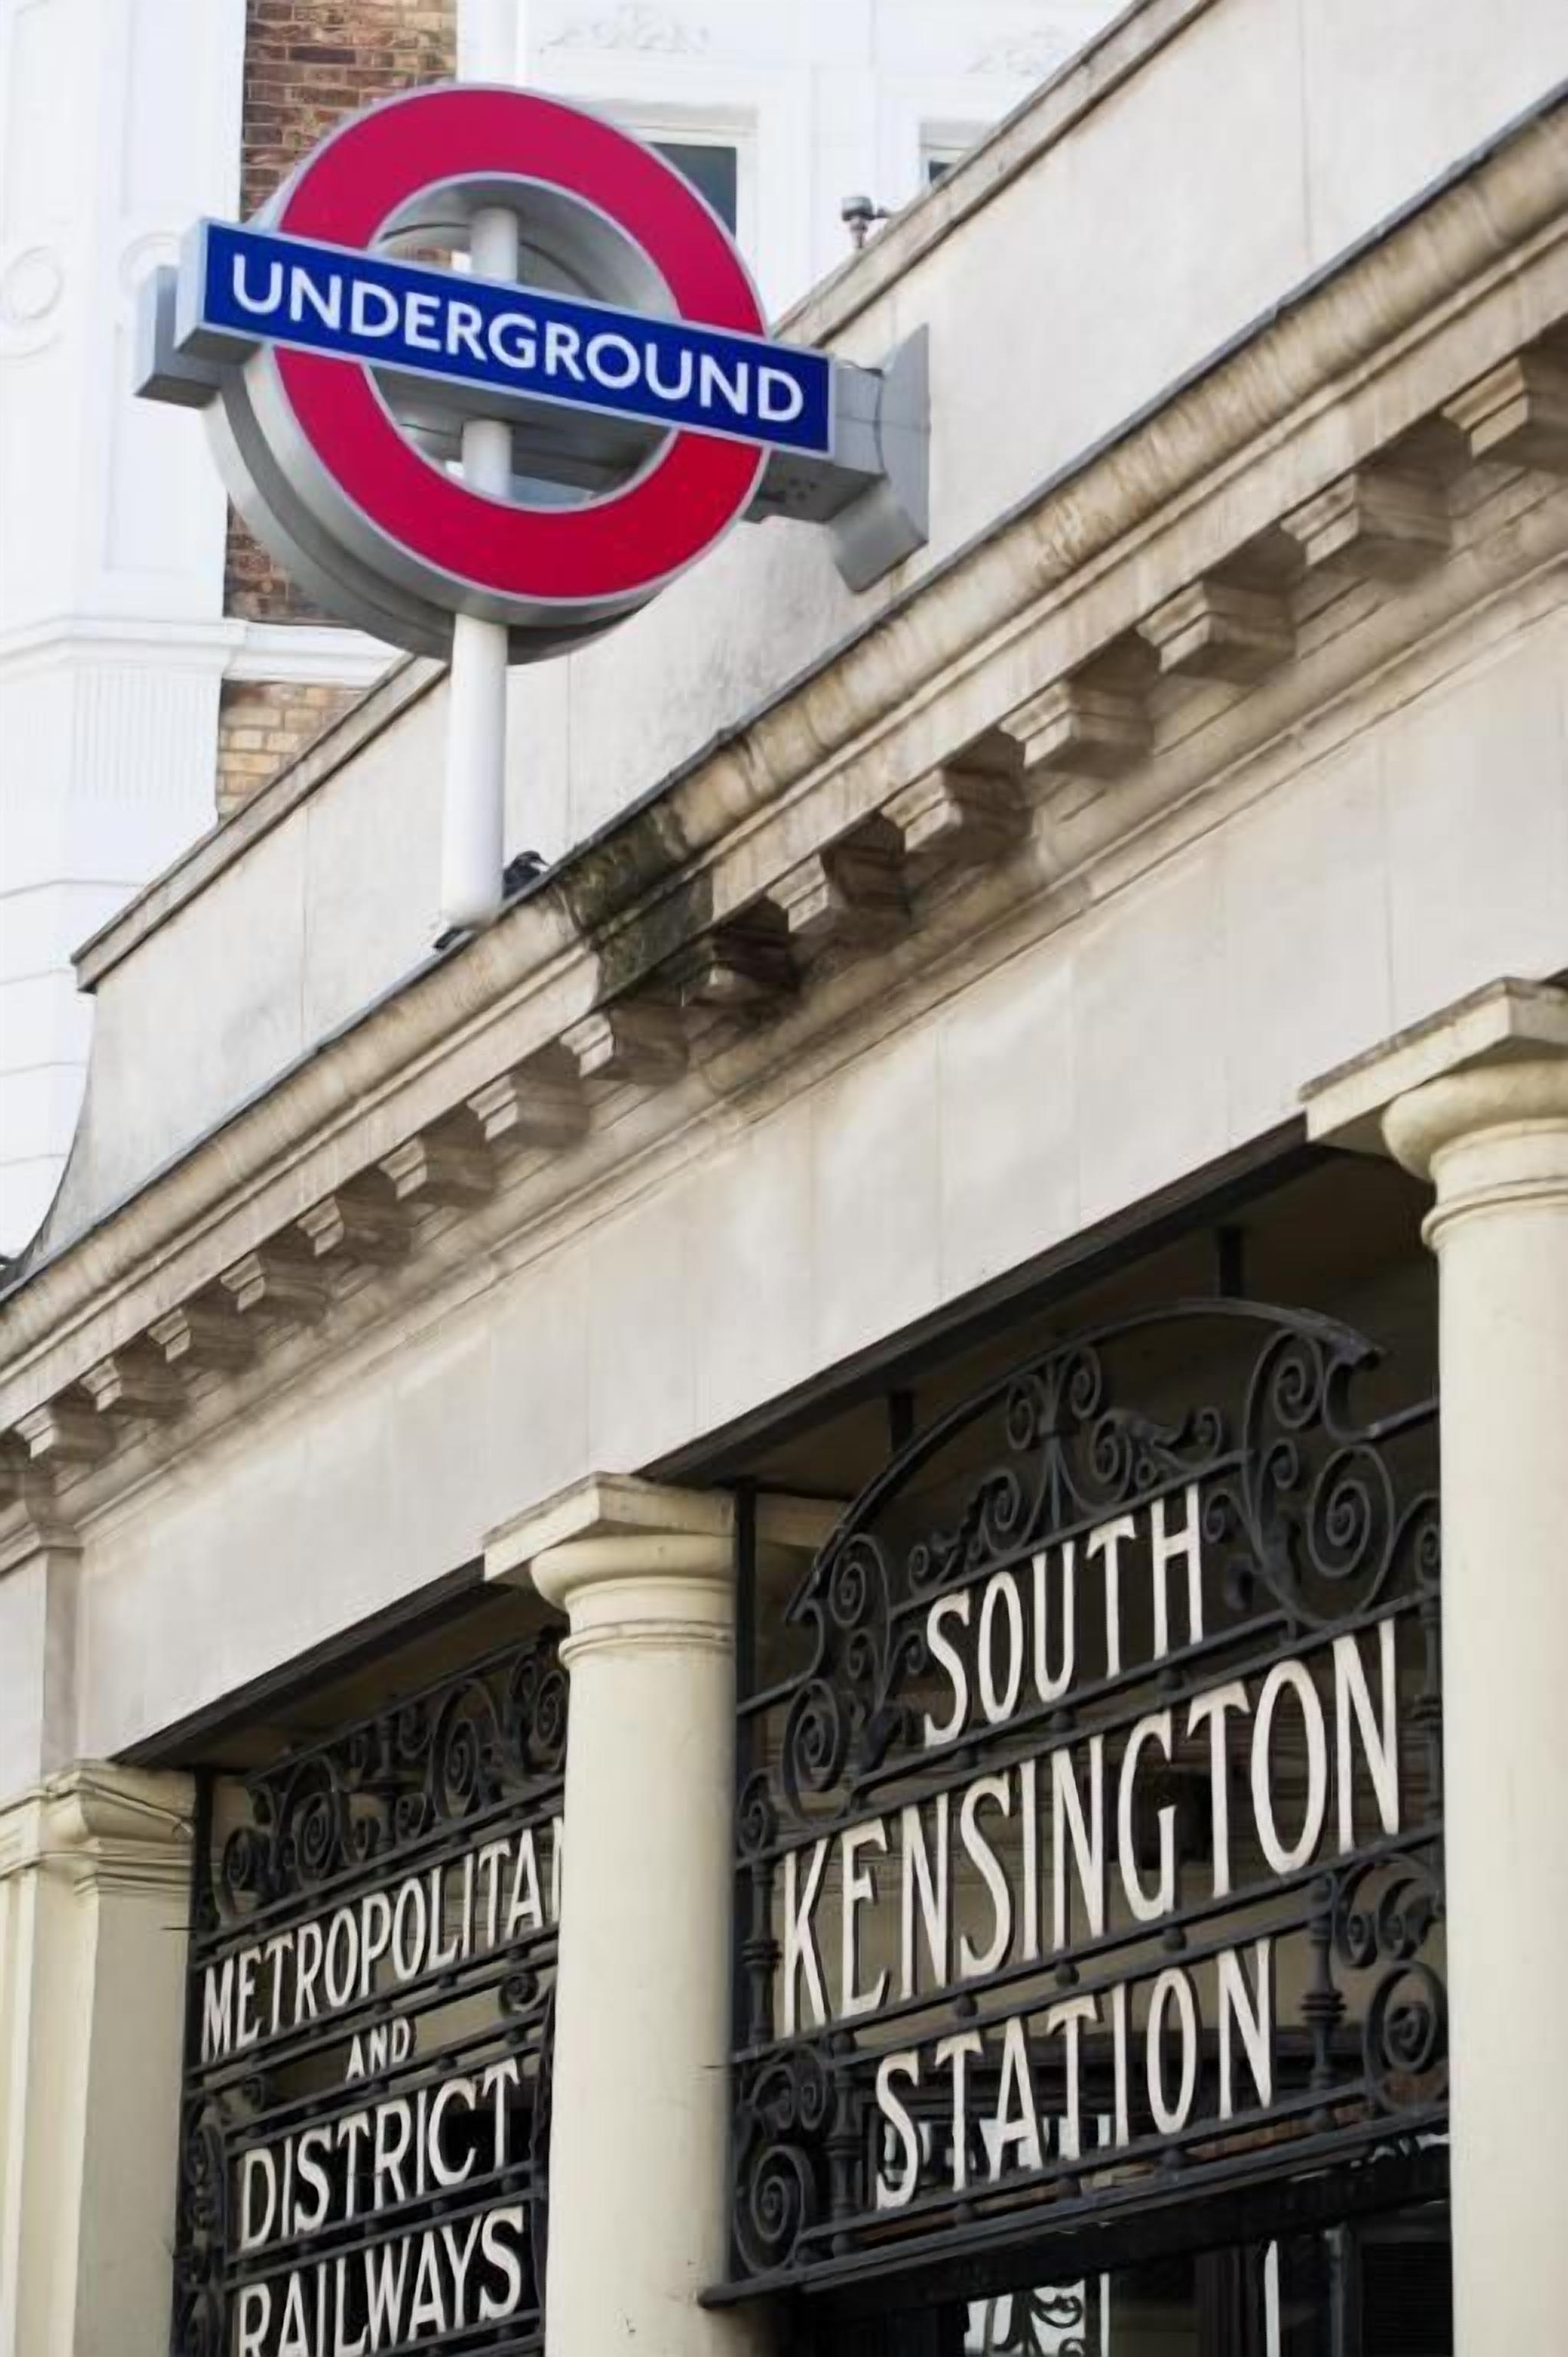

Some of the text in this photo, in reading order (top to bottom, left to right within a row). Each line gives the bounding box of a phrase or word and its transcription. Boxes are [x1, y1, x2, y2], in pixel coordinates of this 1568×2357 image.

[232, 253, 805, 424] UNDERGROUND
[924, 1485, 1204, 1748] SOUTH
[782, 1618, 1401, 2039] KENSINGTON
[346, 2017, 411, 2082] AND
[875, 1938, 1272, 2210] STATION
[239, 2059, 519, 2251] DISTRICT
[238, 2206, 524, 2357] RAILWAYS
